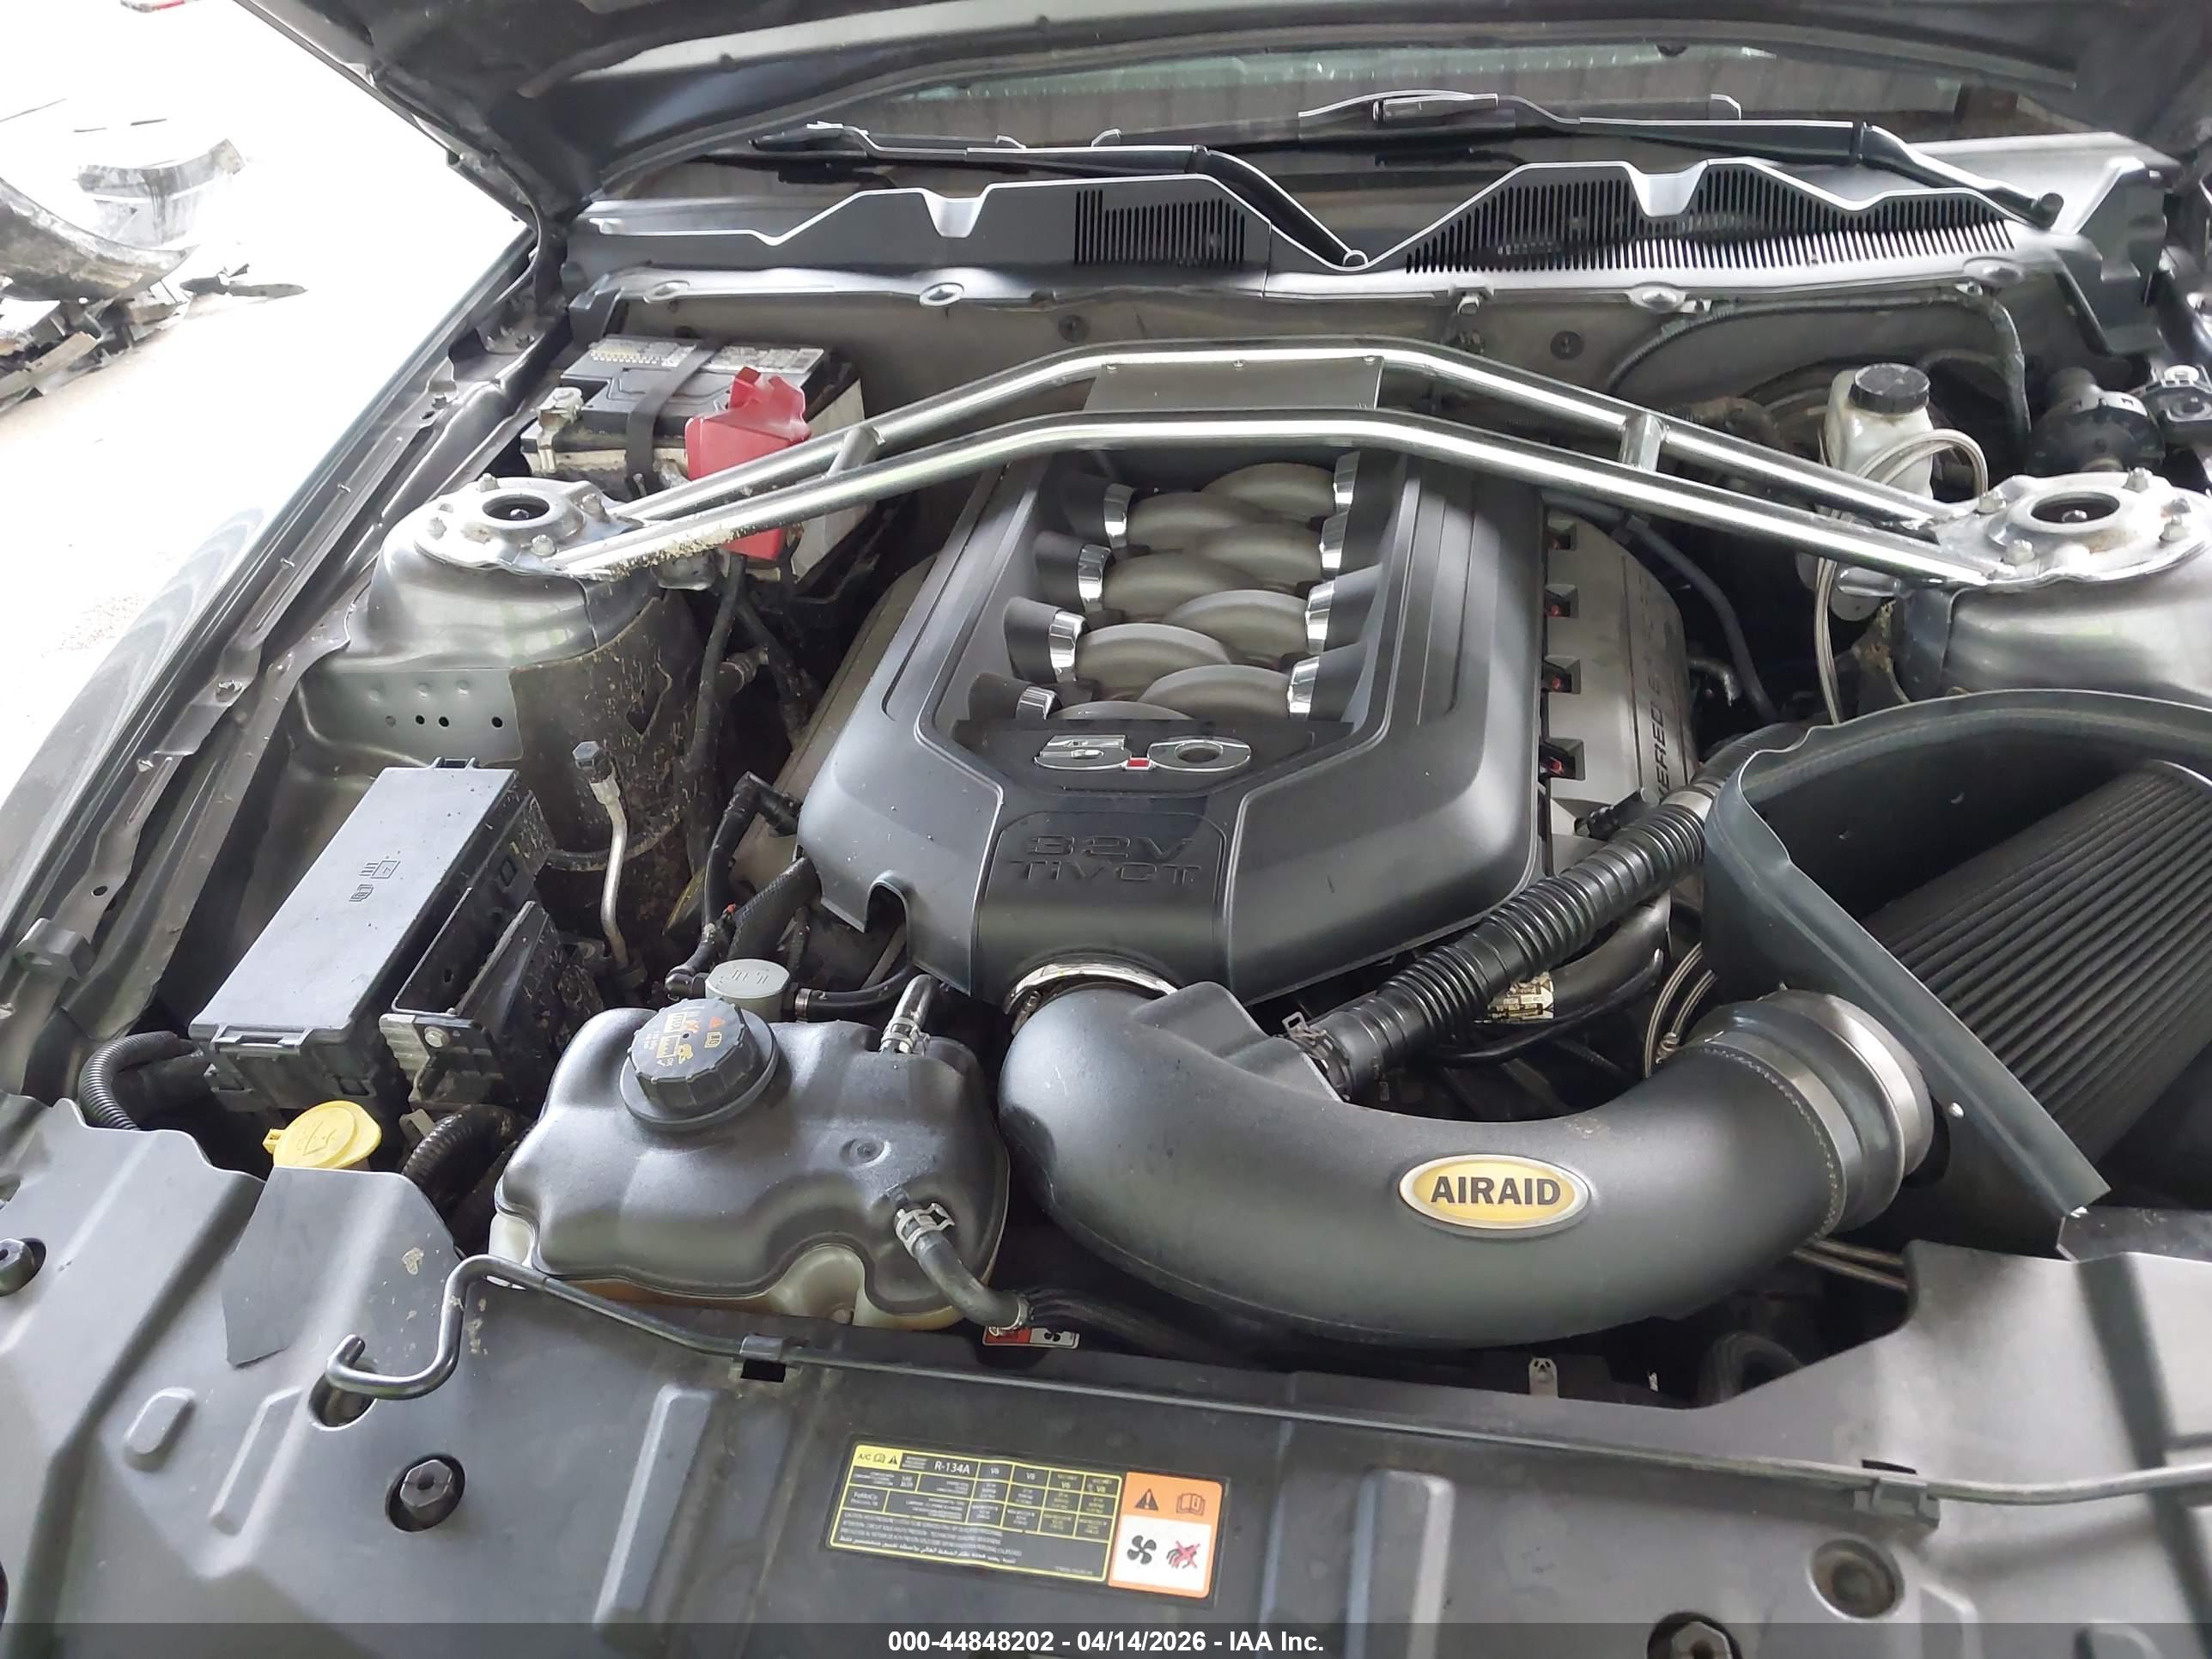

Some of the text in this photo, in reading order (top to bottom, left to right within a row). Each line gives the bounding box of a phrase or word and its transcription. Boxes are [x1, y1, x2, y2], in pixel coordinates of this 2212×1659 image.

[1033, 734, 1252, 772] 5.0
[1430, 1176, 1561, 1206] AIRAID
[934, 1461, 970, 1474] R-134A
